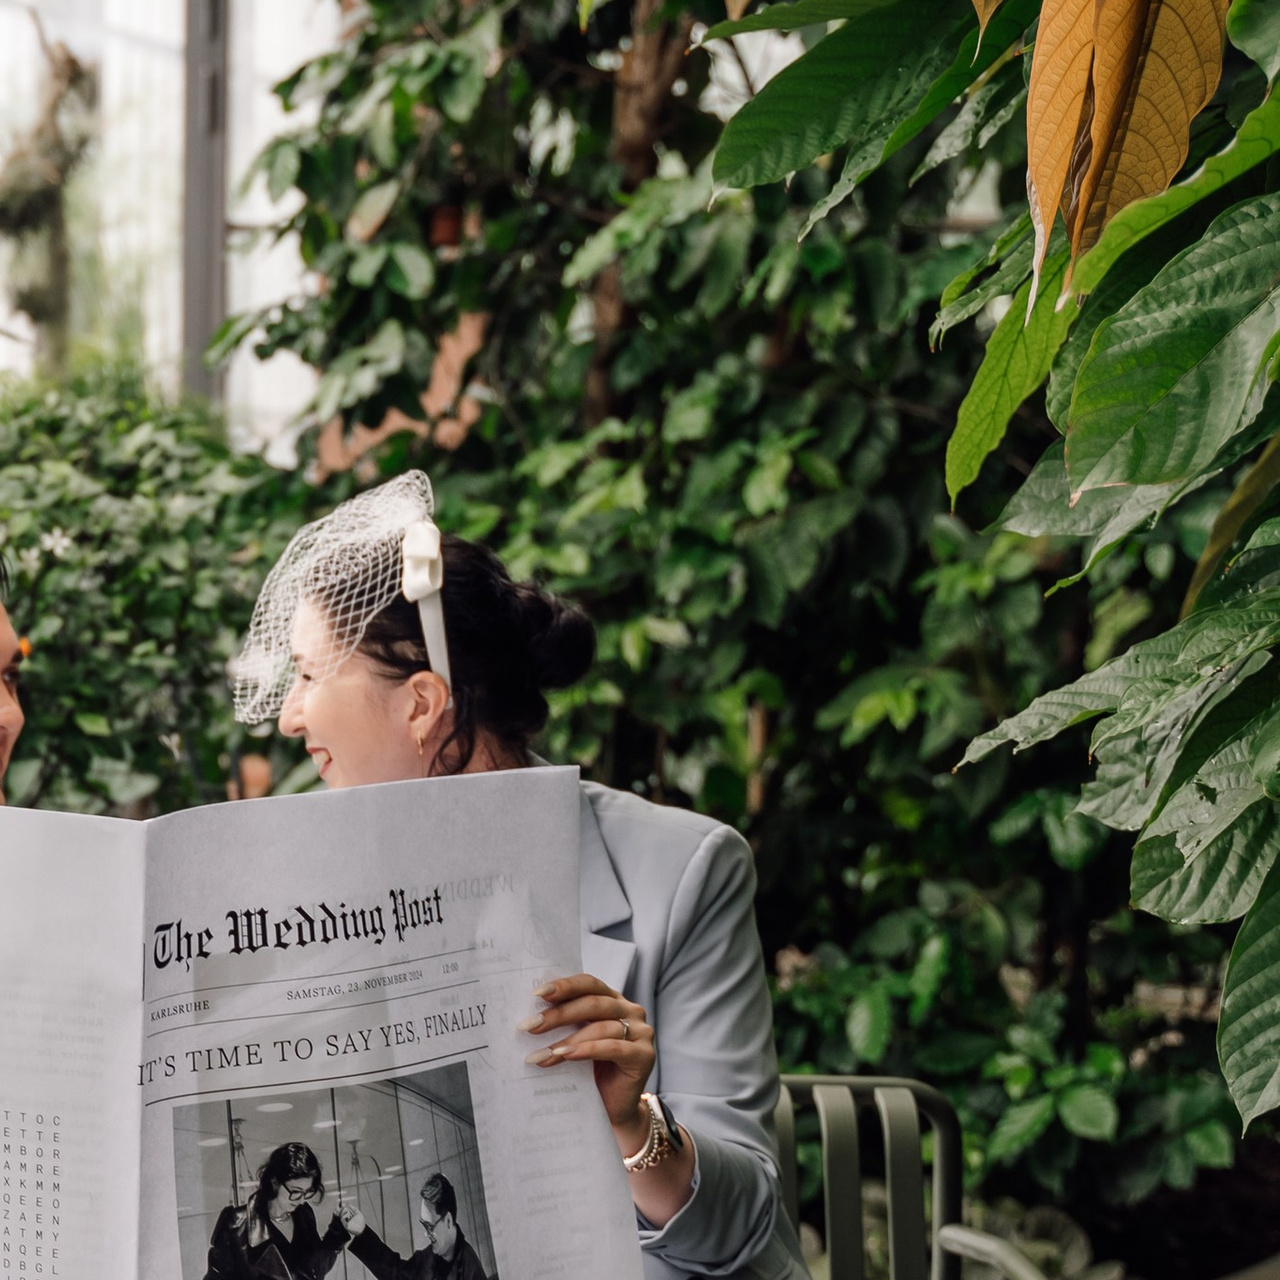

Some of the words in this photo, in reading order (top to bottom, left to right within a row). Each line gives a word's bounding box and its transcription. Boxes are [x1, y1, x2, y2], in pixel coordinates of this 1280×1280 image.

[153, 918, 215, 973] The
[225, 902, 387, 955] Wedding
[389, 887, 444, 943] Post
[442, 961, 459, 974] 12:00
[286, 984, 346, 1001] SAMSTAG,
[347, 980, 363, 994] 23.
[364, 973, 408, 990] NOVEMBER
[150, 999, 210, 1023] KARLSRUHE
[185, 1043, 264, 1073] TIME
[273, 1037, 313, 1062] TO
[325, 1029, 373, 1057] SAY
[380, 1021, 421, 1047] YES,
[423, 1004, 487, 1039] FINALLY
